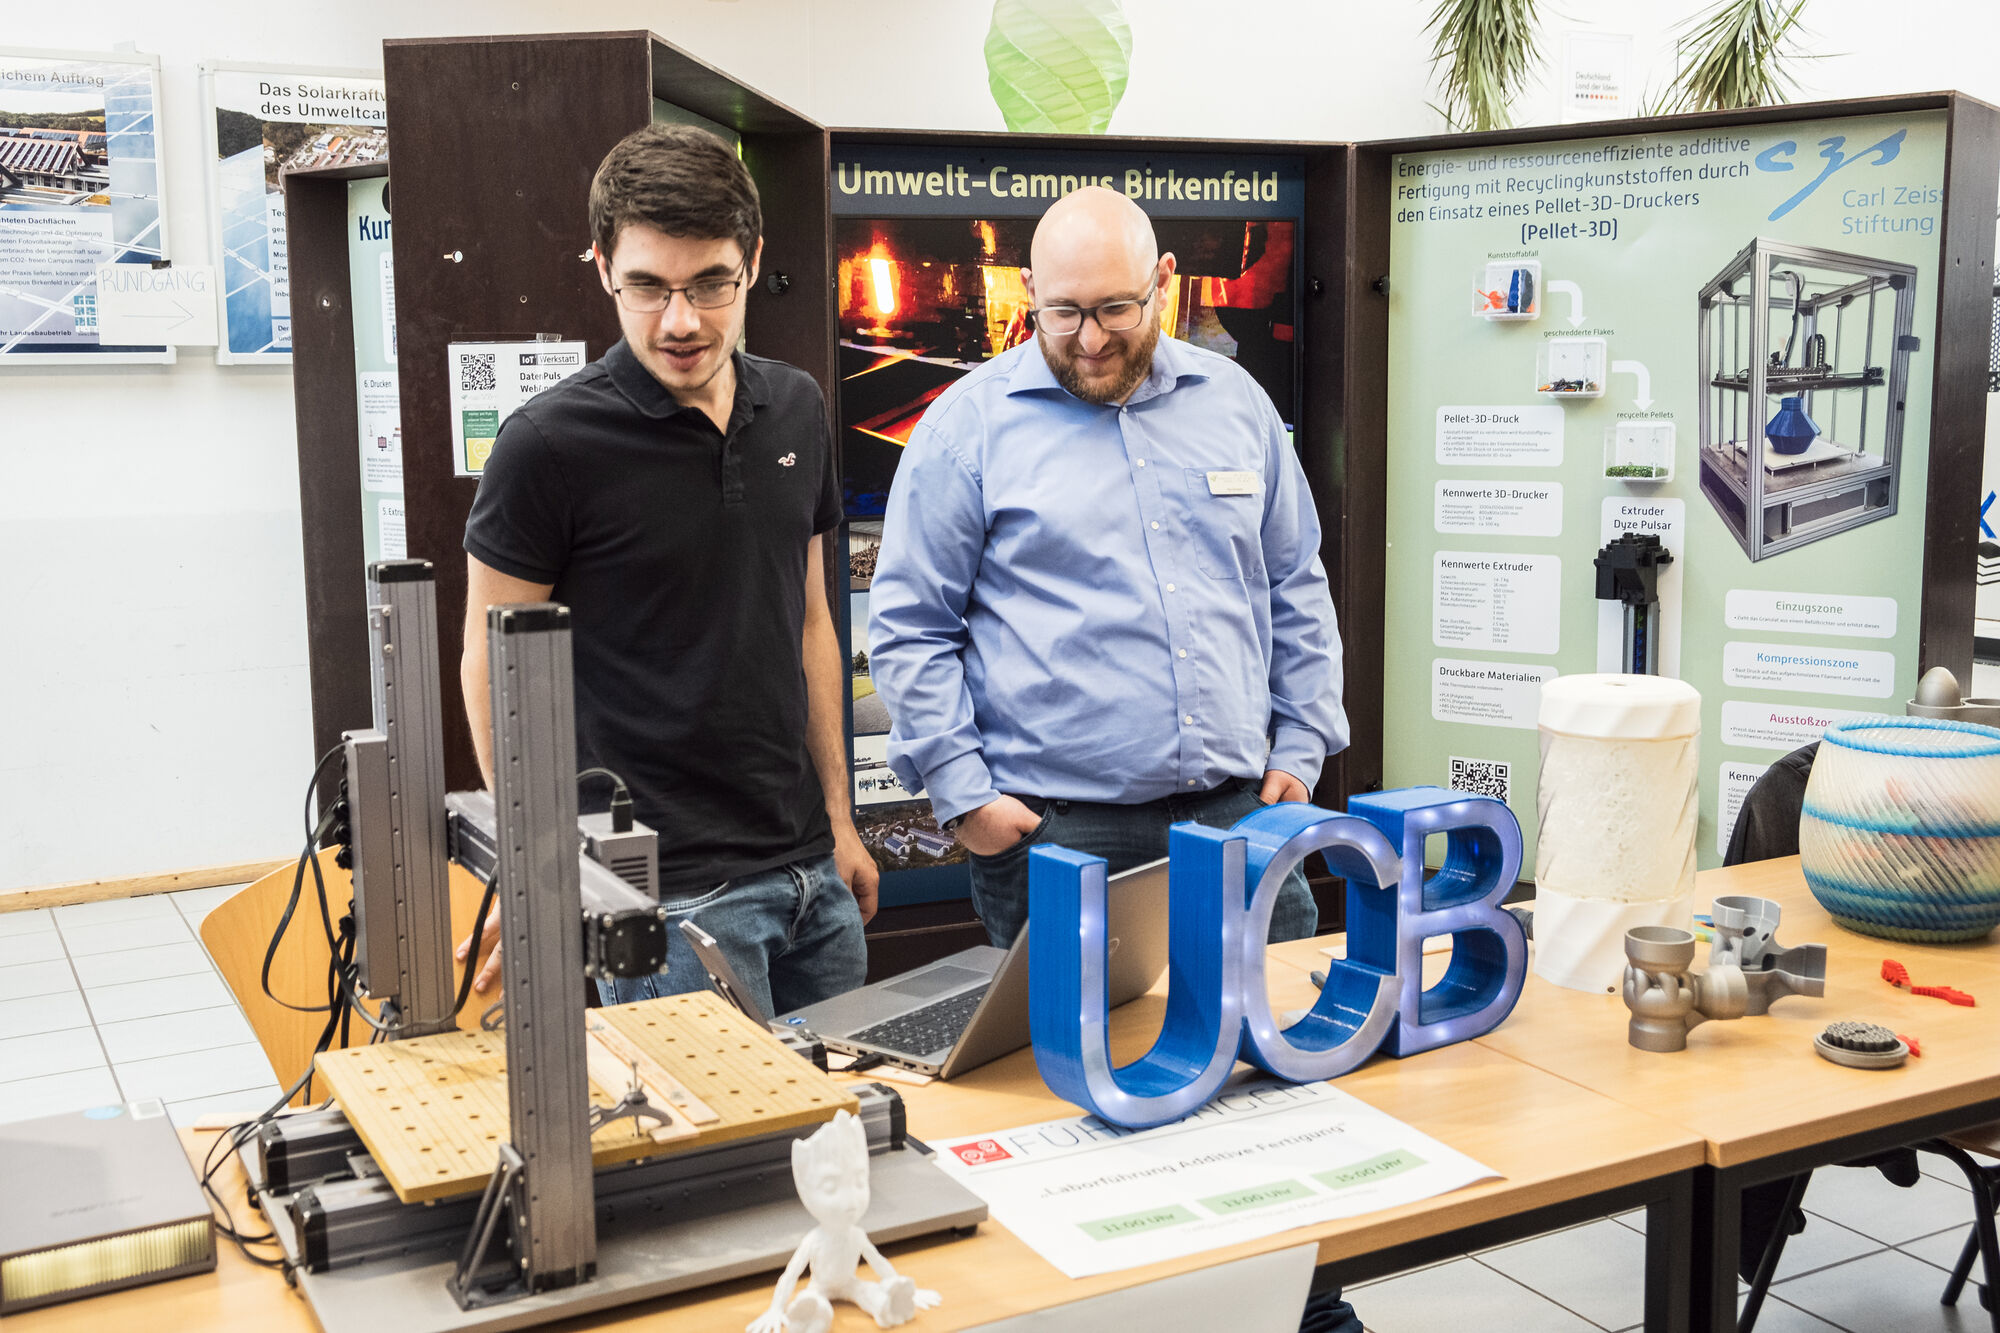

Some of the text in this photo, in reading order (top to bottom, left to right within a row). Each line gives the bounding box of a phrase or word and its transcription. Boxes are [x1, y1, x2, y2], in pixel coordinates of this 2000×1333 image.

[50, 71, 104, 88] Auftrag
[260, 82, 291, 97] Das
[261, 102, 291, 115] des
[1398, 137, 1750, 178] Energie- und ressourceneffiziente additive
[1124, 169, 1278, 202] Birkenfeld
[1398, 161, 1749, 201] Fertigung mit Recyclingkunststoffen durch
[1842, 187, 1885, 208] Carl
[1397, 191, 1700, 222] den Einsatz eines Pellet-3D-Druckers
[1841, 214, 1934, 236] Stiftung
[1487, 250, 1539, 259] Kunststoffabfall
[102, 267, 206, 293] RUNDGANG
[1543, 328, 1615, 337] geschredderte Flakes
[522, 355, 536, 364] IoT
[370, 379, 392, 388] Drucken
[1444, 414, 1520, 424] Pellet-3D-Druck
[1616, 411, 1674, 420] recycelte Pellets
[1442, 488, 1549, 500] Kennwerte 3D-Drucker
[1621, 506, 1665, 516] Extruder
[1613, 519, 1672, 530] Dyze Pulsar
[1441, 559, 1534, 572] Kennwerte Extruder
[1775, 601, 1844, 614] Einzugszone
[1757, 652, 1860, 669] Kompressionszone
[1440, 666, 1541, 683] Druckbare Materialien
[1028, 785, 1527, 1128] UCB
[1179, 1148, 1253, 1168] Additive
[1376, 1158, 1403, 1172] Uhr
